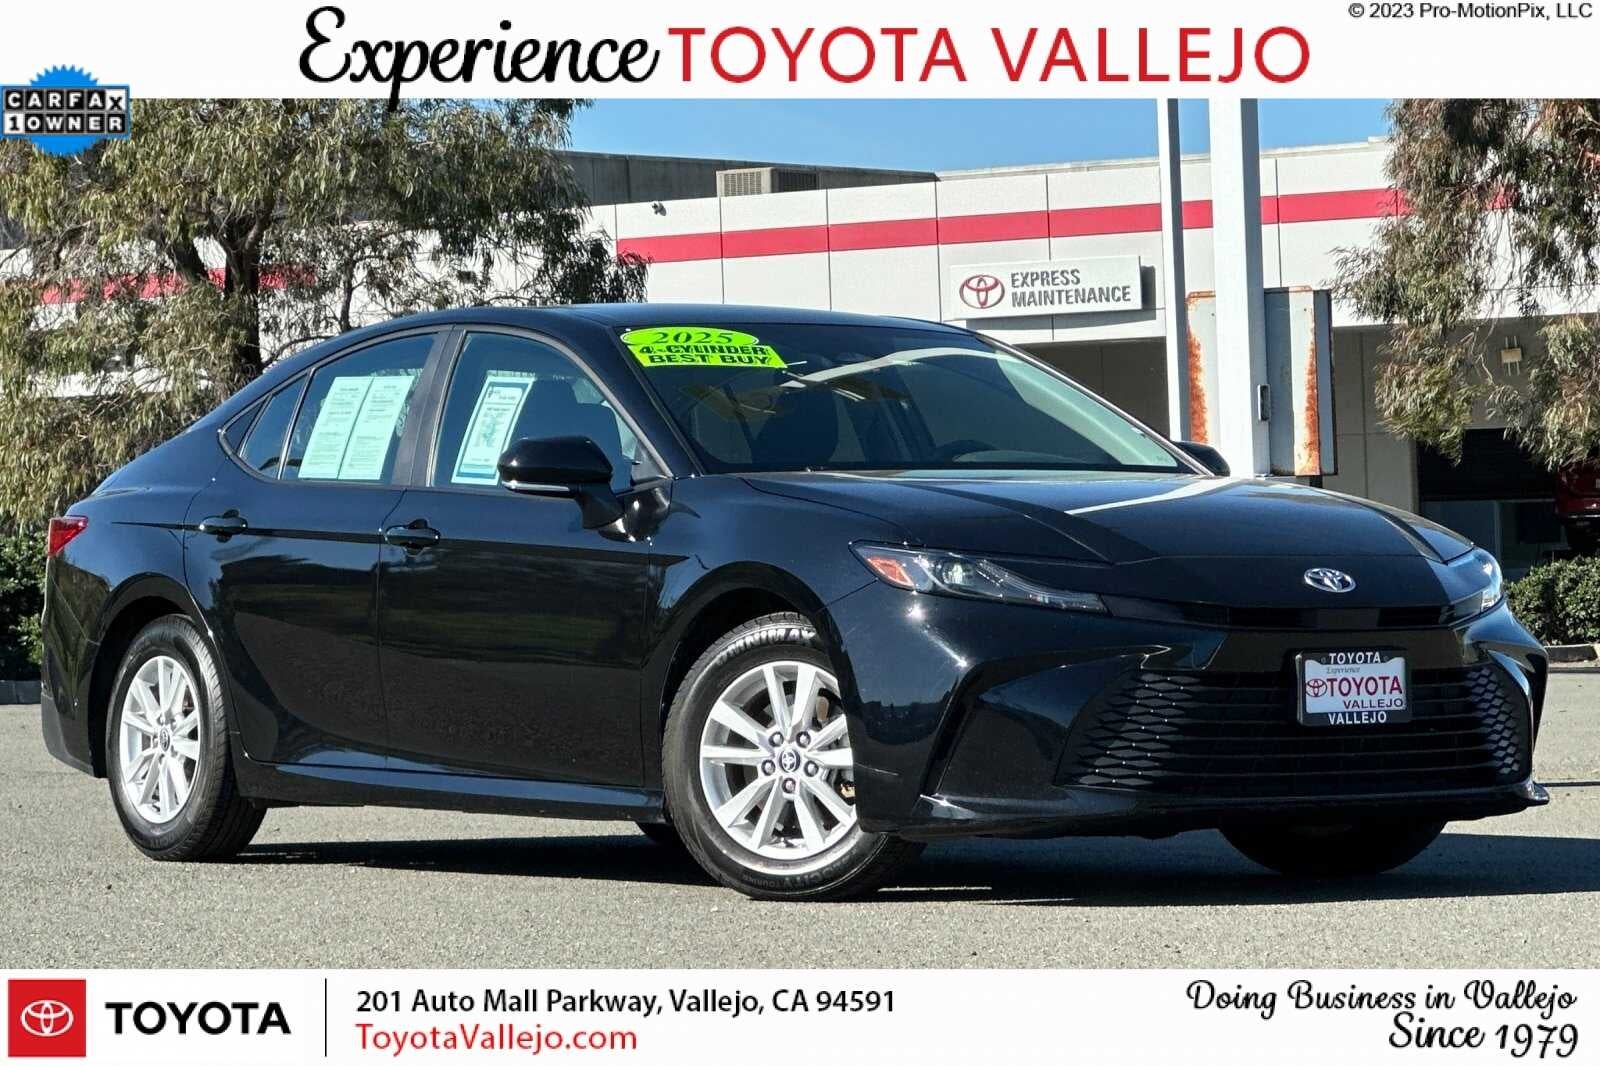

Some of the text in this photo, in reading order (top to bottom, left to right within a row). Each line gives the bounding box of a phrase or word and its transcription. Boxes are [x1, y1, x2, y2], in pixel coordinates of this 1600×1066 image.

[1011, 269, 1081, 288] EXPRESS
[1011, 285, 1132, 308] MAINTENANCE
[651, 331, 734, 345] 2025
[649, 354, 769, 364] BEST BUY
[1328, 651, 1381, 665] TOYOTA
[1326, 675, 1403, 697] TOYOTA
[1343, 697, 1404, 710] VALLEJO
[1327, 710, 1388, 725] VALLEJO
